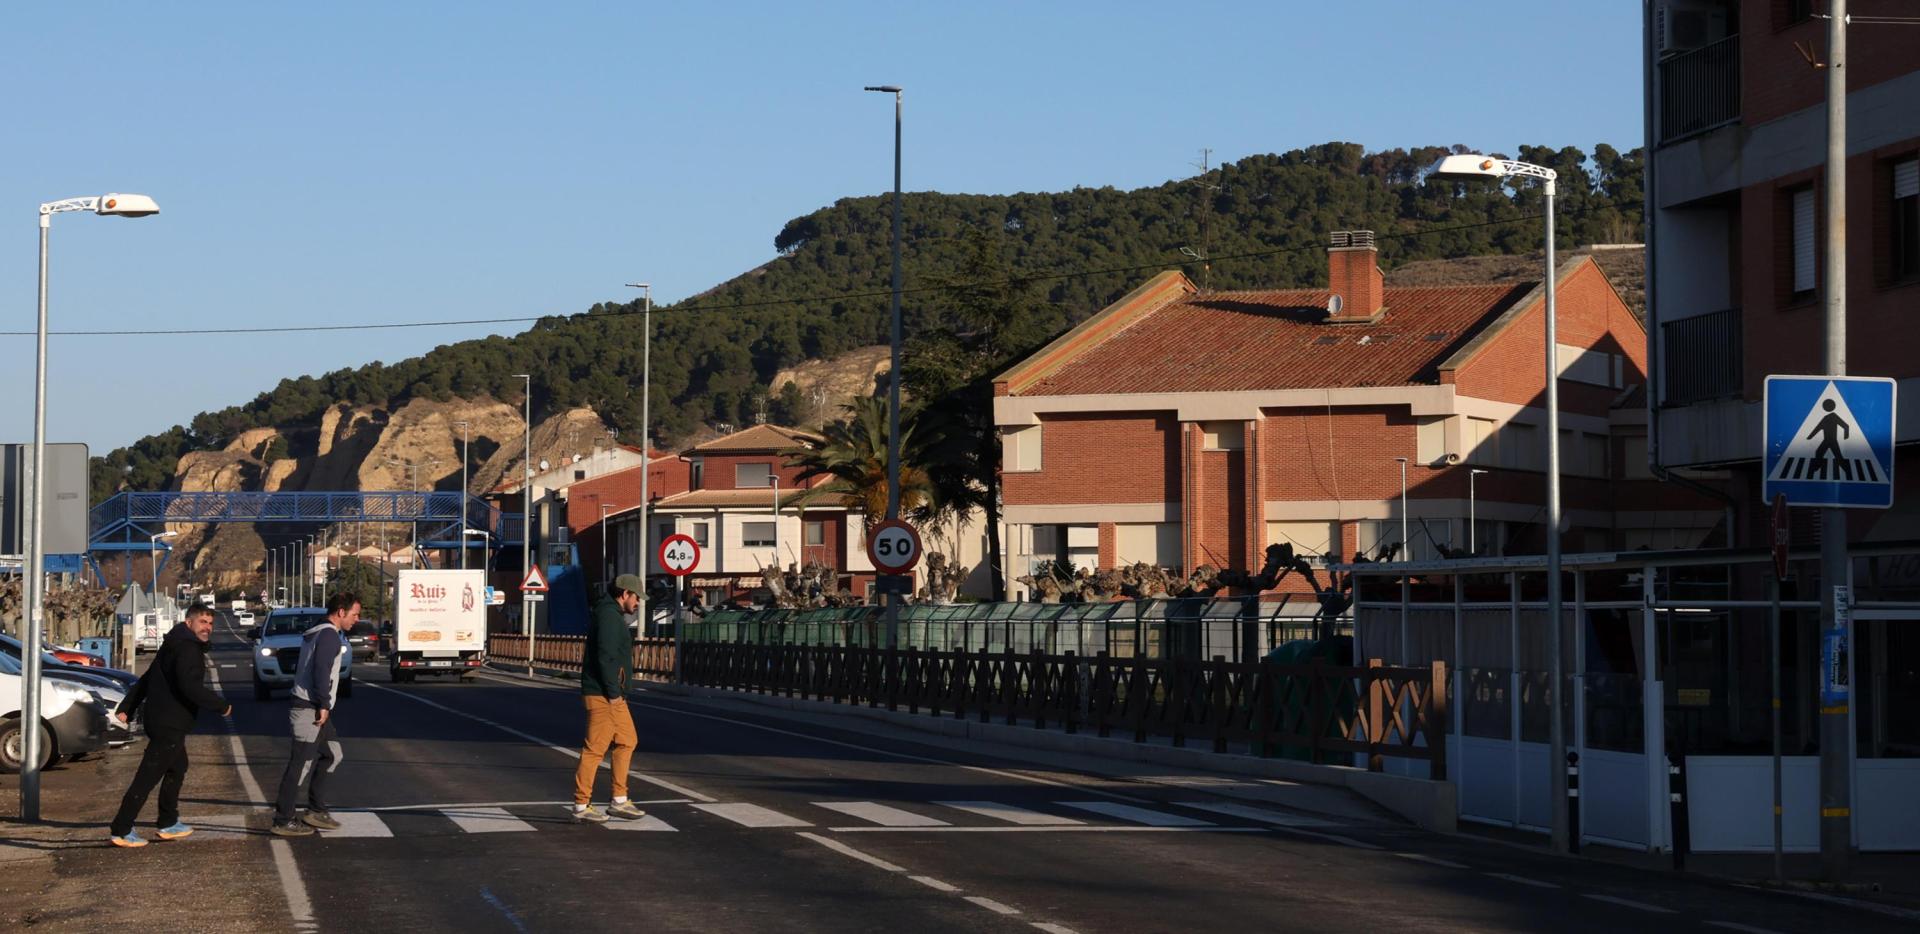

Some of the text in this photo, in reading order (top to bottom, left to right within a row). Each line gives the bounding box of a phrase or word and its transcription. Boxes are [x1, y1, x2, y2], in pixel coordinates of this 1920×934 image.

[1776, 528, 1789, 545] STOP
[667, 549, 686, 561] 4,8
[879, 538, 911, 556] 50
[410, 583, 447, 601] Ruiz
